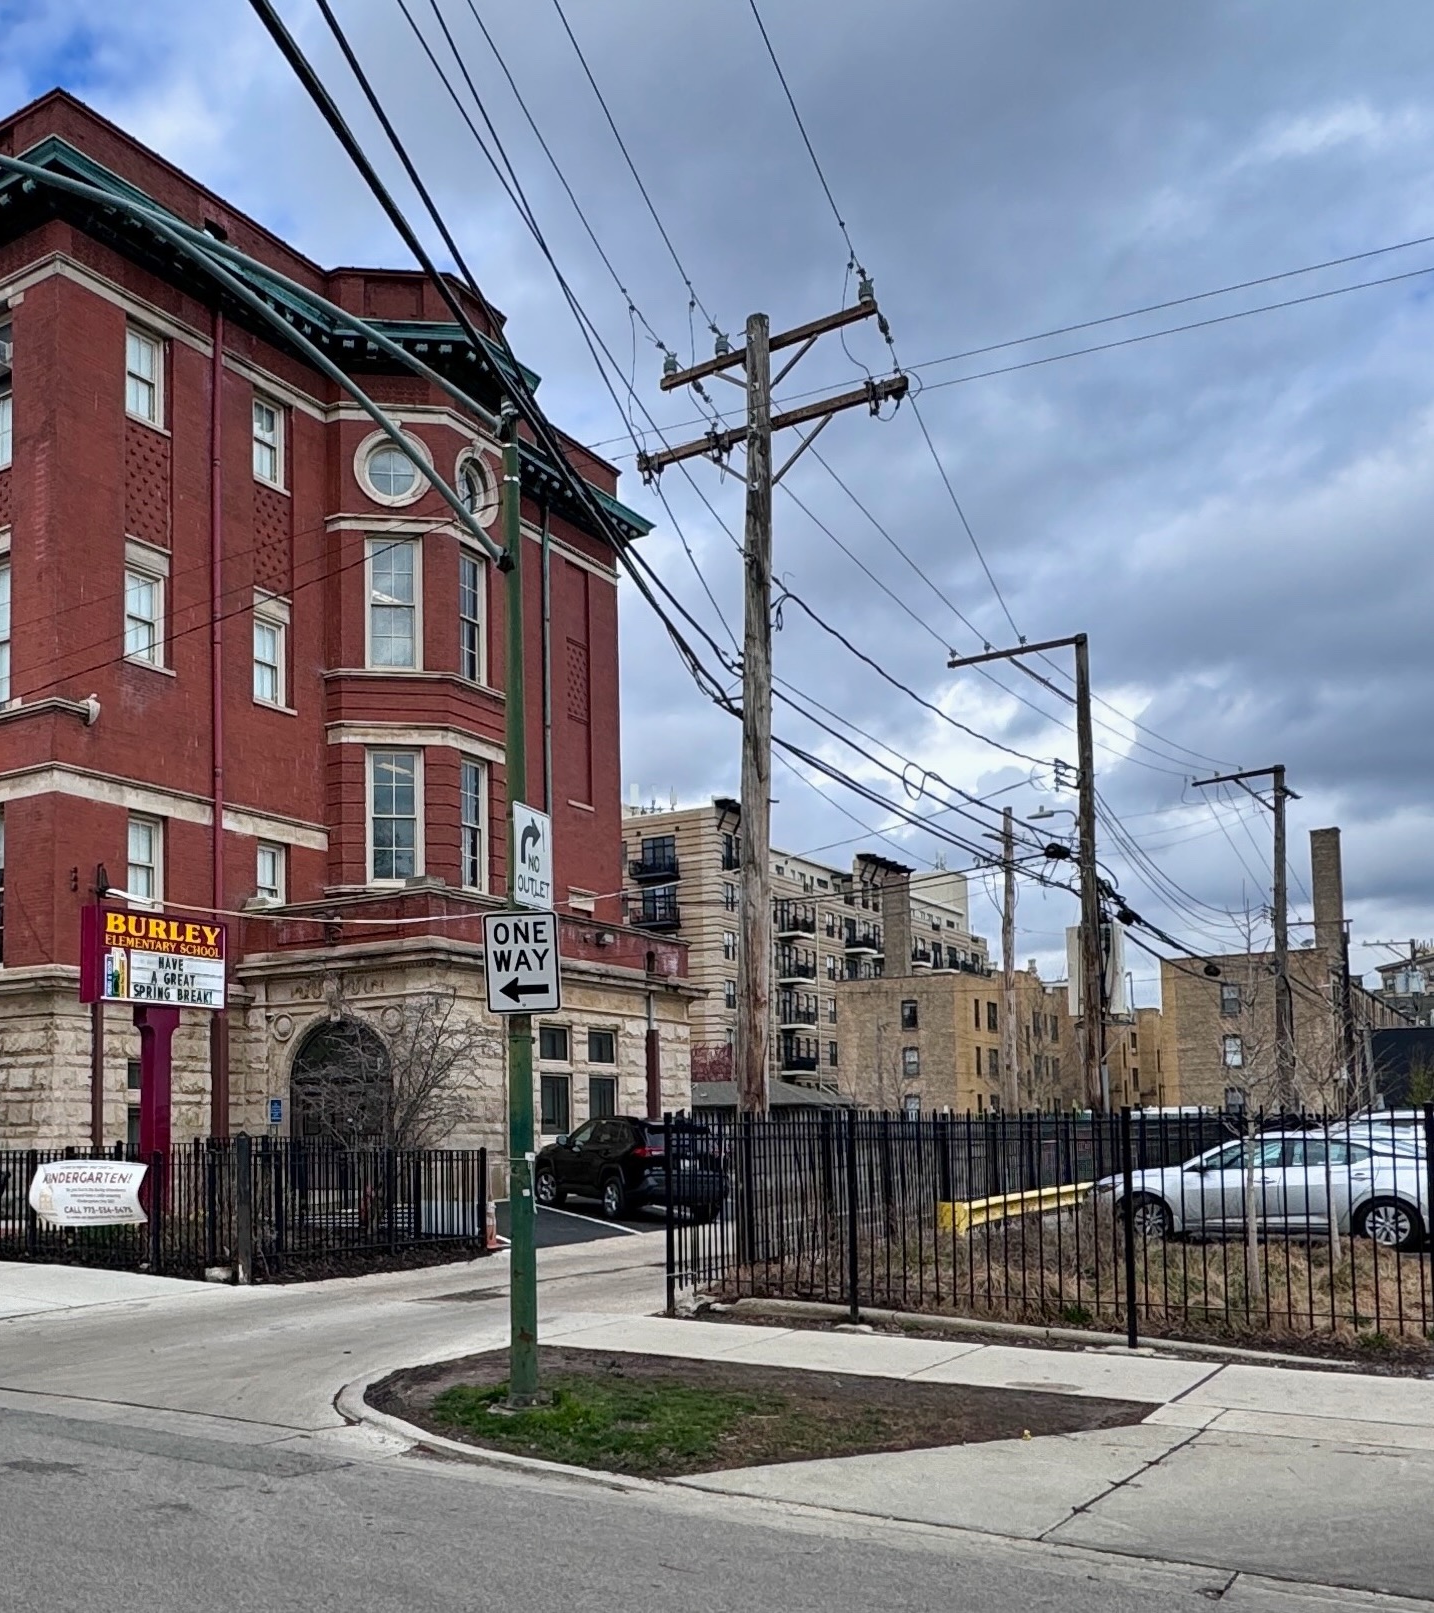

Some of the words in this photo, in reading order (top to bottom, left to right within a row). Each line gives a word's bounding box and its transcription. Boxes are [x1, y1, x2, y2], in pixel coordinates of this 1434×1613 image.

[528, 853, 540, 872] NO
[517, 873, 550, 899] OUTLET
[106, 913, 221, 945] BURLEY
[493, 921, 548, 945] ONE
[105, 934, 177, 953] ELEMENTARY
[180, 943, 221, 958] SCHOOL
[158, 957, 184, 971] HAVE
[492, 948, 550, 972] WAY
[151, 971, 158, 983] A
[163, 973, 196, 987] GREAT
[133, 984, 171, 1000] SPRING
[177, 989, 213, 1005] BREAK!
[64, 1206, 82, 1214] CALL
